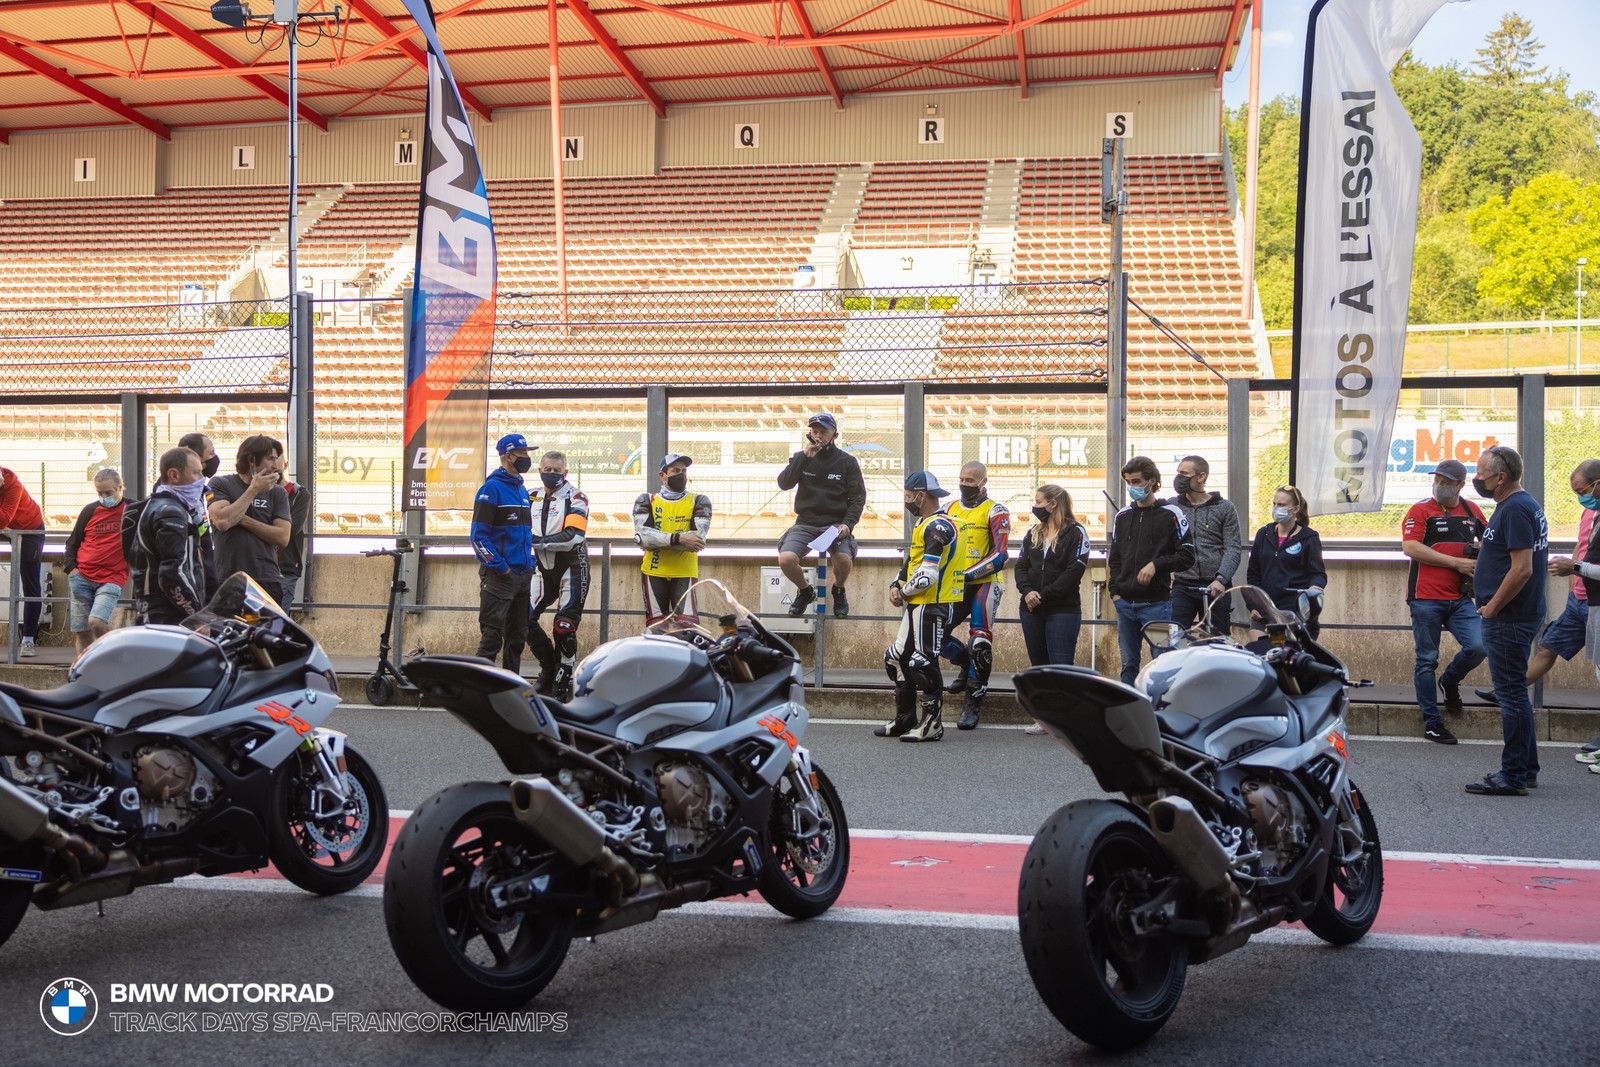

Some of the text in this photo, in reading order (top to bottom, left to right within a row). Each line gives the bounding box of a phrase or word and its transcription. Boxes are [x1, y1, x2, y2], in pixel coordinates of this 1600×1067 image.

[925, 120, 938, 142] R
[1113, 114, 1126, 136] S
[740, 125, 754, 147] Q
[238, 148, 248, 167] L
[400, 143, 412, 163] M
[565, 138, 578, 159] N
[83, 160, 87, 179] I
[979, 273, 995, 294] T
[1331, 90, 1377, 504] MOTOS À L'ESSAI
[591, 433, 613, 443] next
[317, 449, 375, 481] eloy
[412, 447, 475, 469] BMC
[857, 457, 905, 470] ESTE
[410, 489, 456, 497] #bmcmoto
[411, 480, 476, 488] bmc-moto.com
[251, 498, 268, 508] EZ
[770, 577, 780, 585] 20
